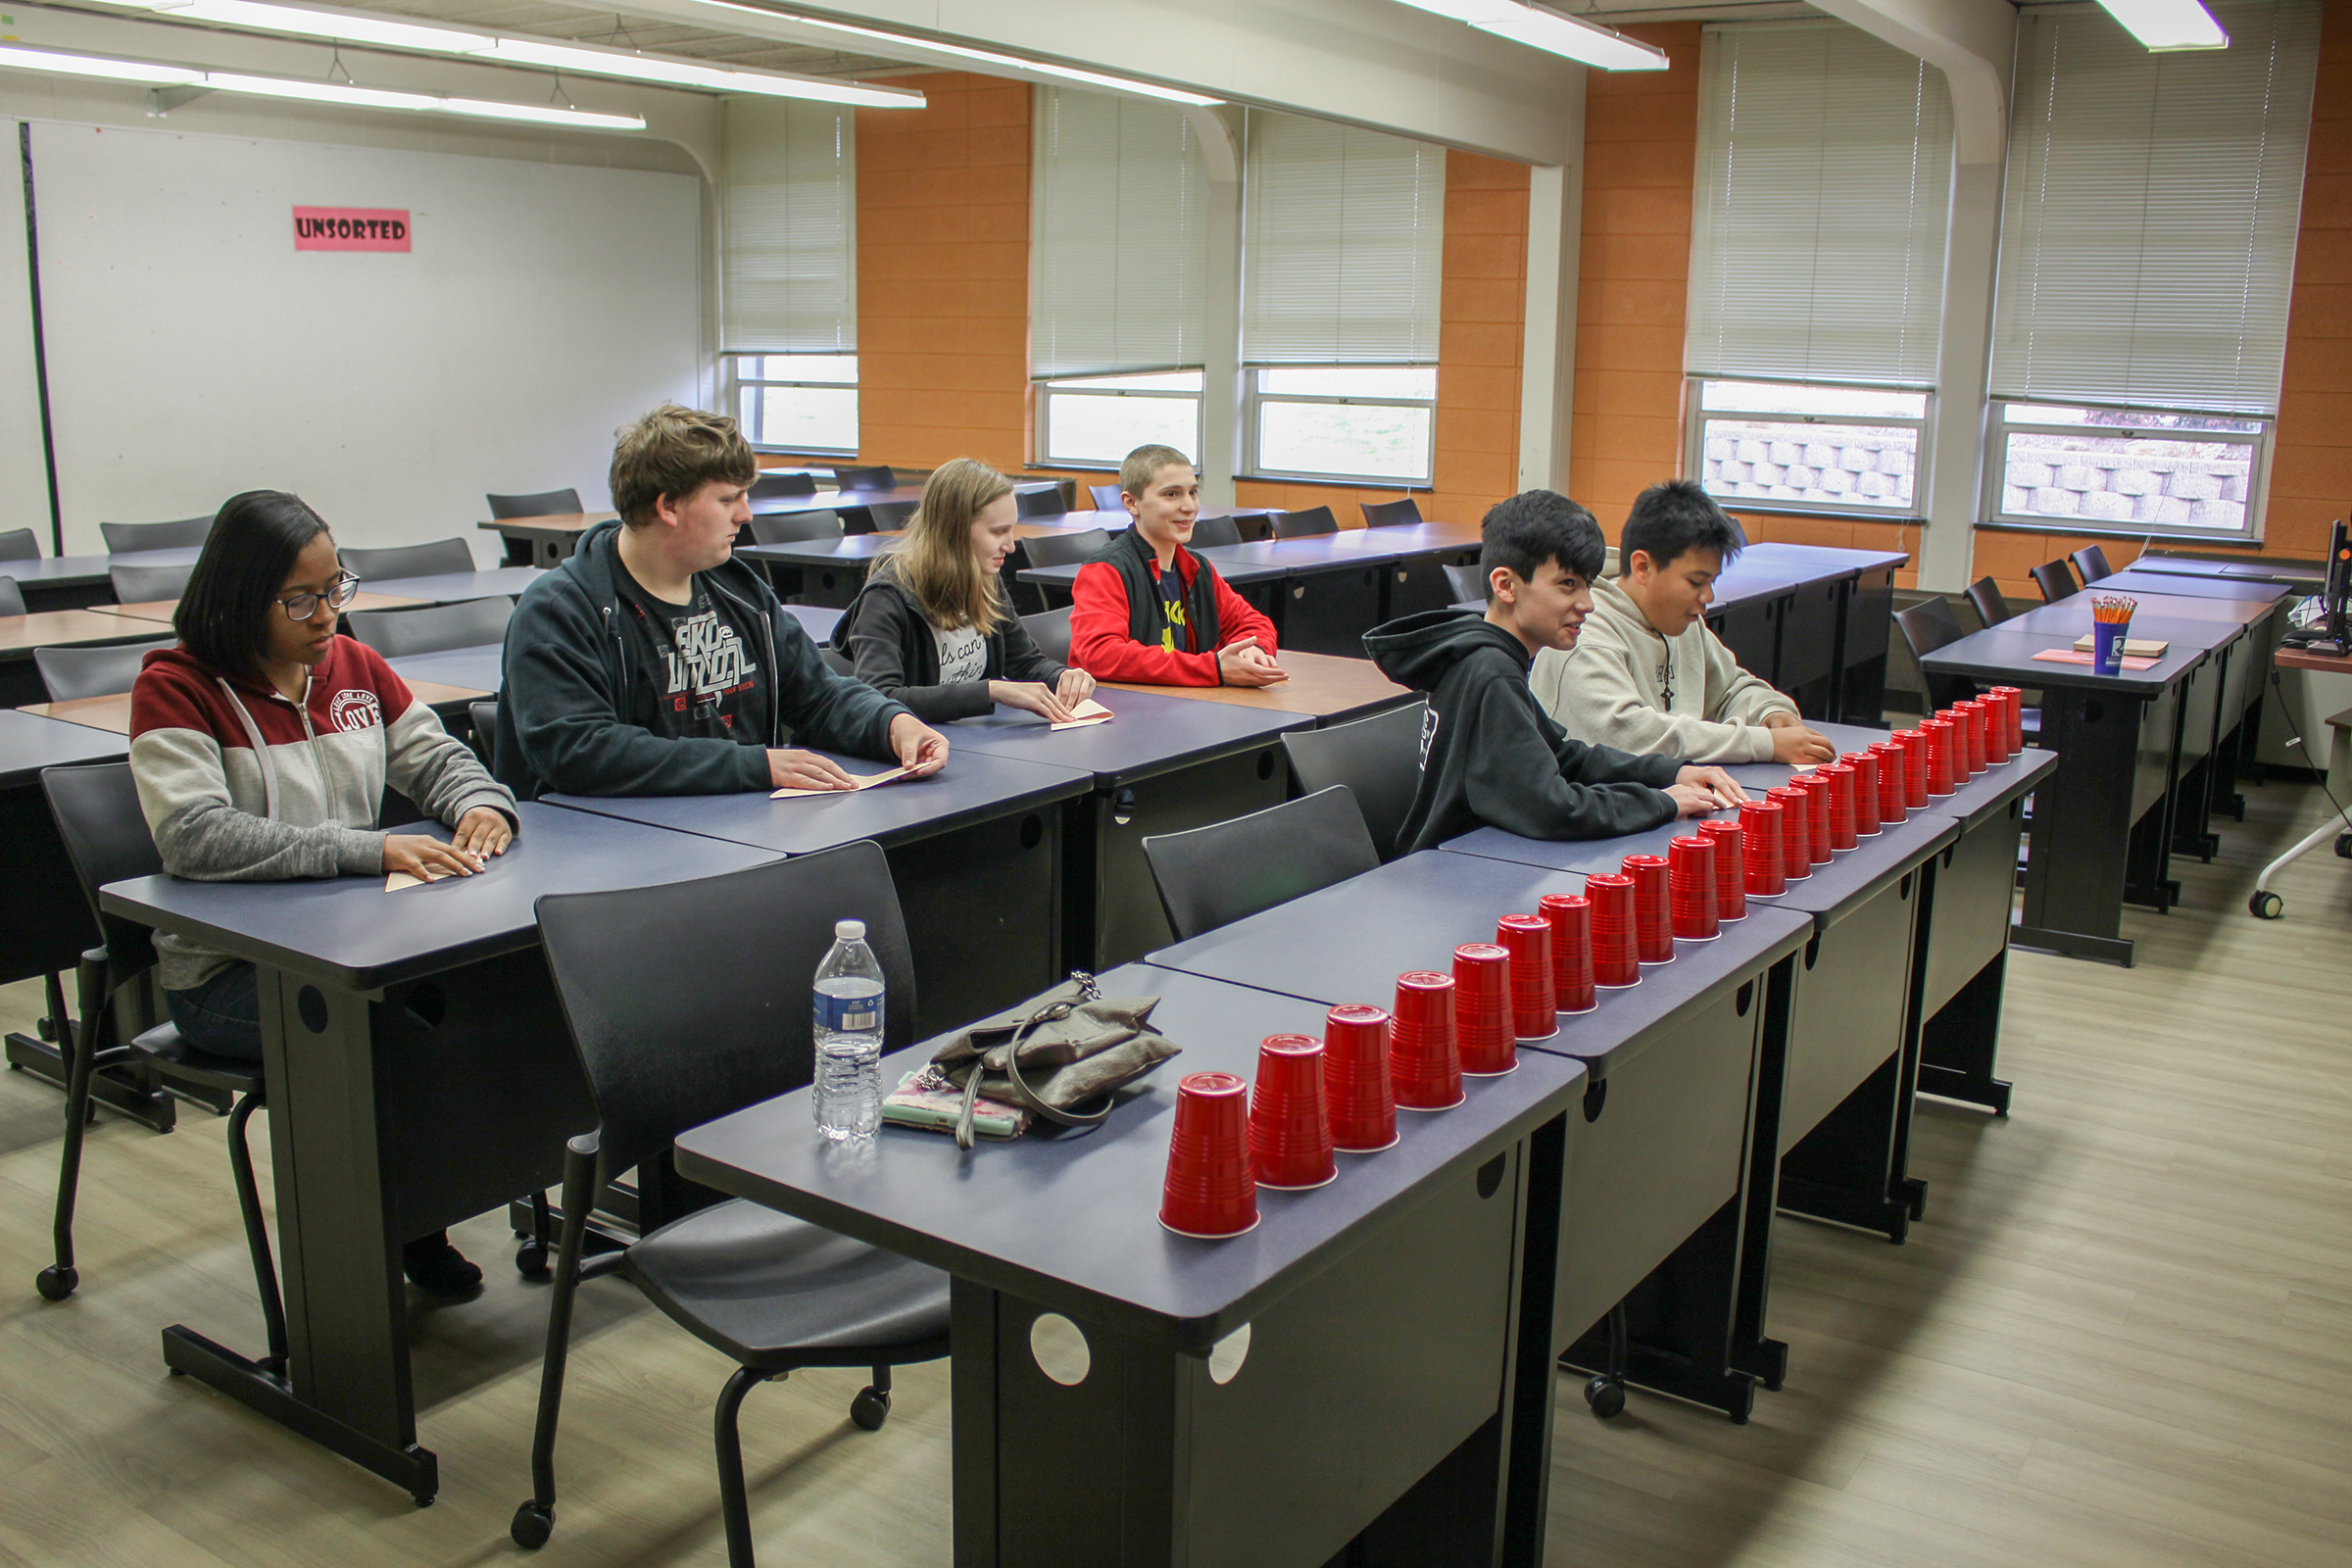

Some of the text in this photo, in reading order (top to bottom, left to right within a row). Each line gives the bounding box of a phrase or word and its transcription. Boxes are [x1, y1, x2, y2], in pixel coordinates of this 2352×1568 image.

[296, 218, 405, 239] UNSORTED
[957, 638, 981, 660] can
[357, 692, 374, 703] LOVE
[334, 703, 382, 732] LOVE
